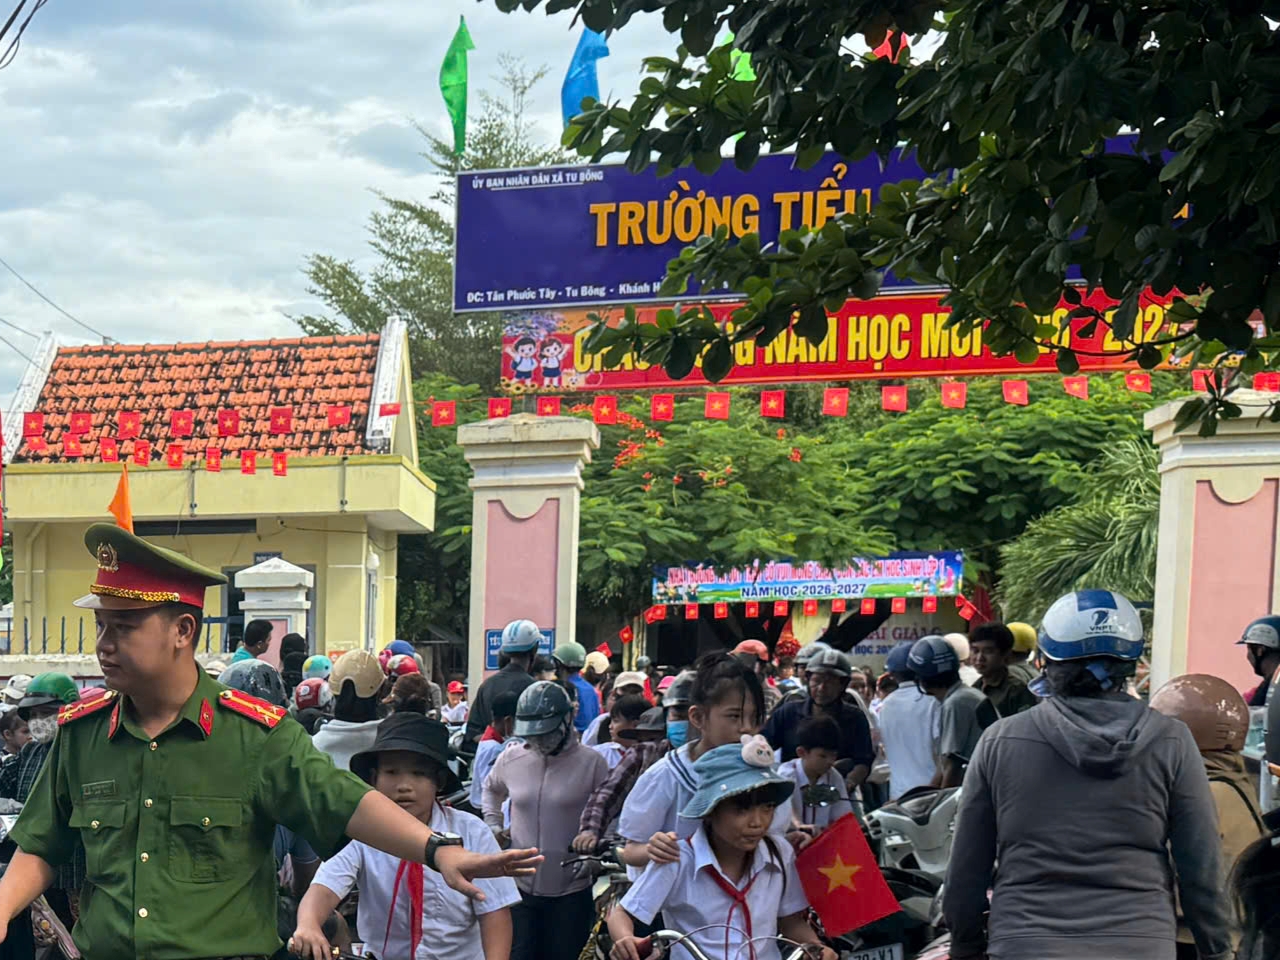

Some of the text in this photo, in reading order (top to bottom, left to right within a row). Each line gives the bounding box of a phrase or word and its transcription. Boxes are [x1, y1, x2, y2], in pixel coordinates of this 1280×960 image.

[486, 178, 504, 188] BAN
[505, 174, 530, 186] NHÂN
[551, 171, 564, 183] XÃ
[565, 172, 578, 182] TU
[579, 170, 604, 182] BÔNG
[589, 180, 760, 247] TRƯỜNG
[565, 286, 578, 297] Tu
[619, 281, 650, 294] Khánh
[847, 313, 911, 370] HỌC
[773, 584, 797, 598] HỌC
